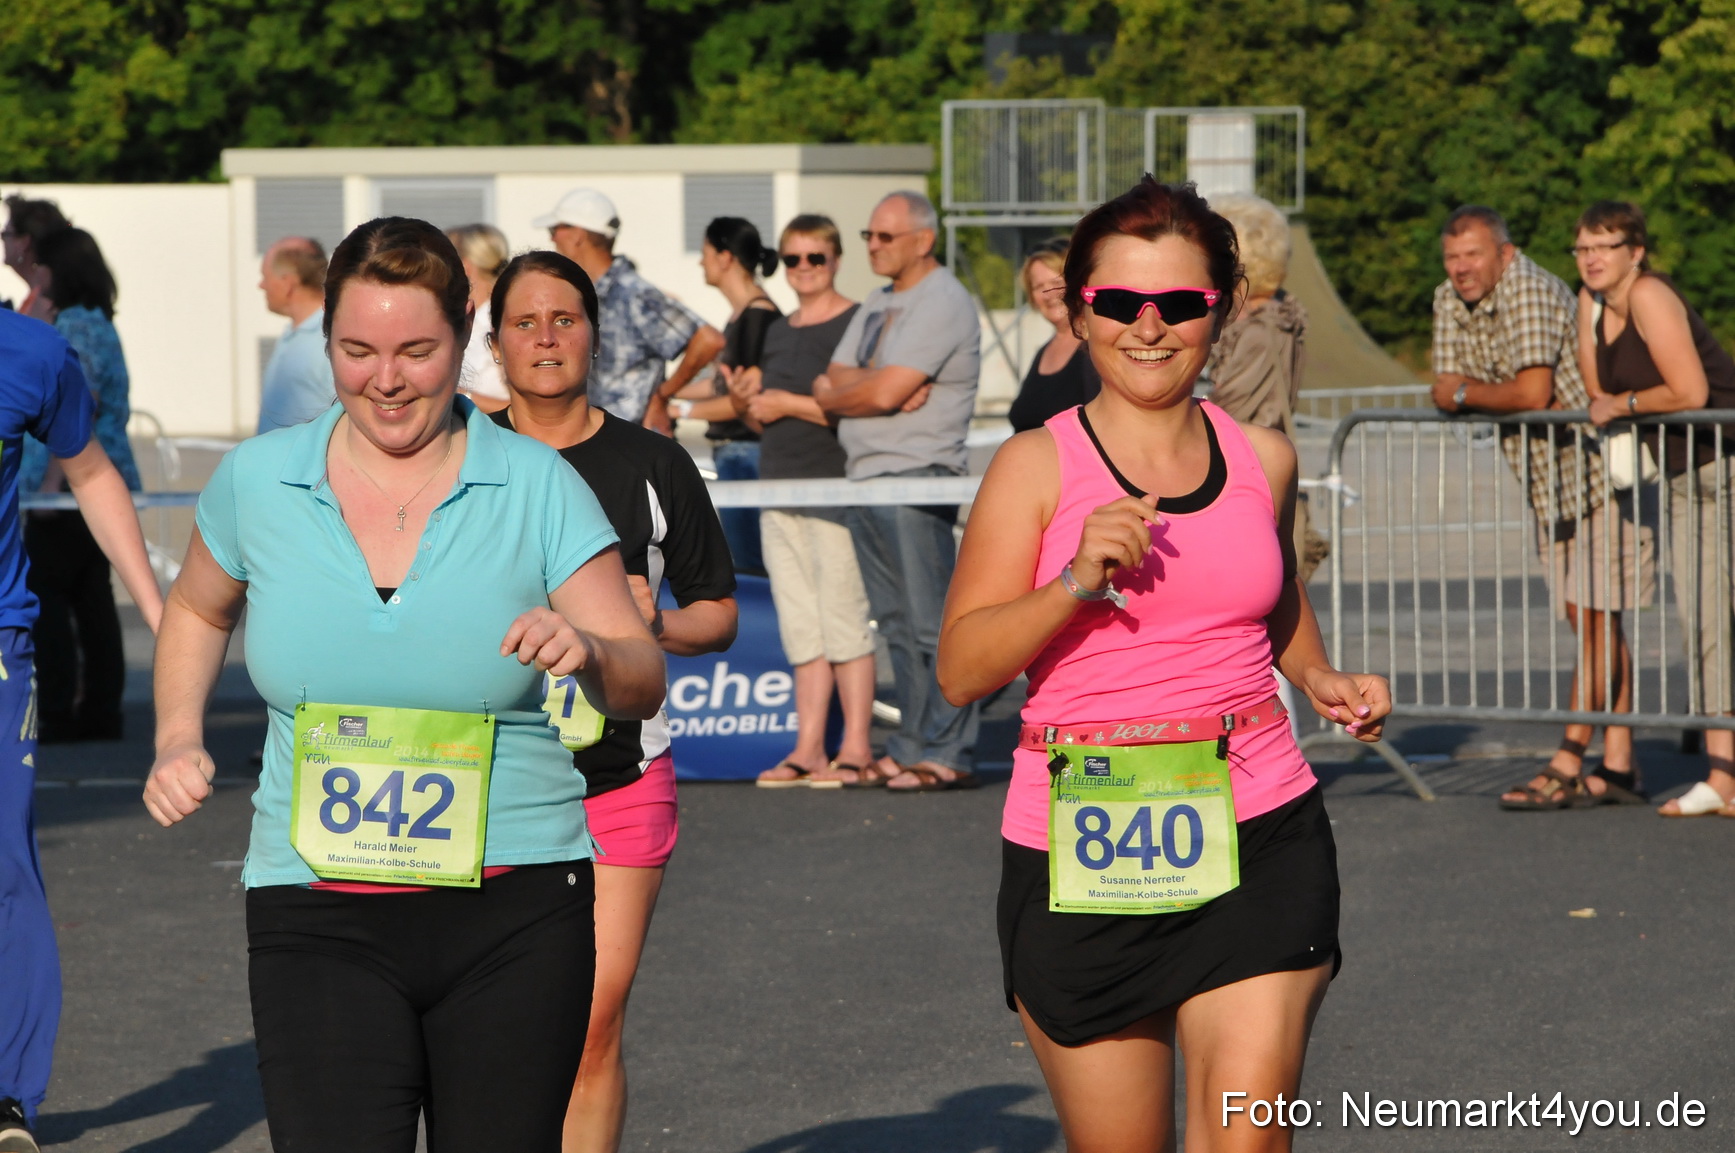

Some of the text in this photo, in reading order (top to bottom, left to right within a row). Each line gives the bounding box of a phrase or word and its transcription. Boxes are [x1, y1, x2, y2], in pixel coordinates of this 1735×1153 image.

[324, 732, 394, 749] firmenlauf
[560, 733, 583, 742] GmbH
[393, 744, 430, 758] 2014
[1073, 773, 1136, 787] firmenlauf
[1138, 779, 1173, 793] 2014
[319, 766, 456, 841] 842
[1074, 804, 1204, 870] 840
[354, 840, 418, 854] Harald Meier
[327, 853, 441, 869] Maximilian-Kolbe-Schule
[1099, 874, 1186, 885] Susanne Nerreter
[1088, 888, 1199, 899] Maximilian-Kolbe-Schule
